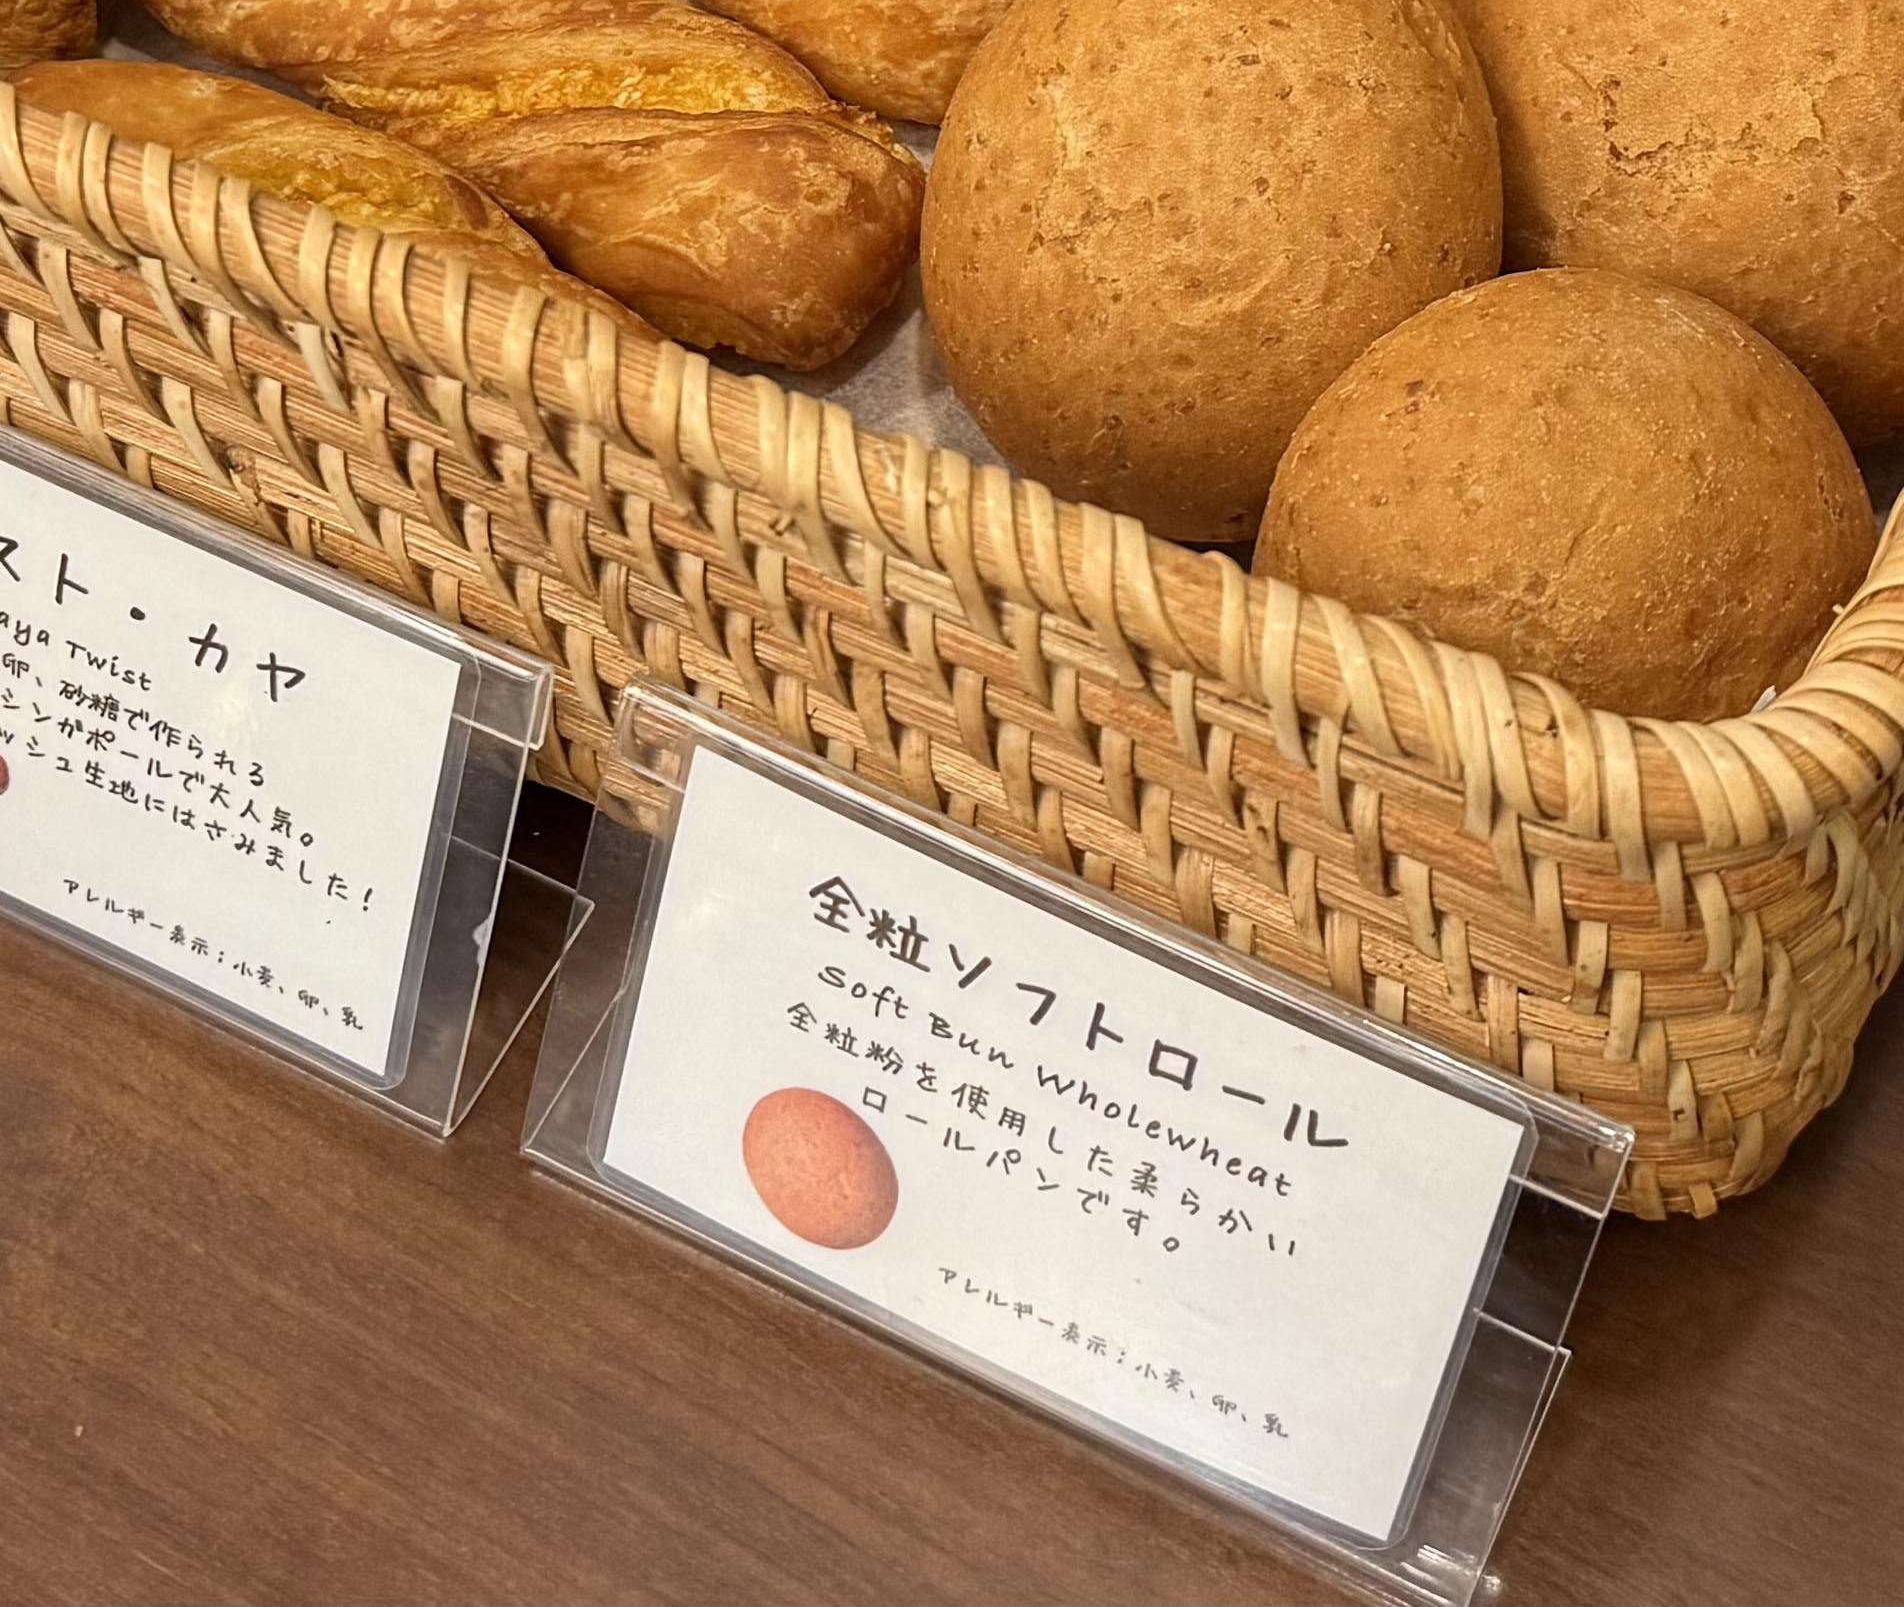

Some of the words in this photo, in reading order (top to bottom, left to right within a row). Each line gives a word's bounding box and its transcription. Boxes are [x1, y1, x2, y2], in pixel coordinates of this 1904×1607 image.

[65, 639, 153, 691] Twist
[808, 874, 1349, 1148] 全粒ソフトロール
[817, 964, 909, 1020] Soft
[928, 1011, 1014, 1070] Bun
[787, 1001, 1297, 1257] 全粒粉を使用した柔らかい
[862, 1086, 1181, 1254] ロールパンです。
